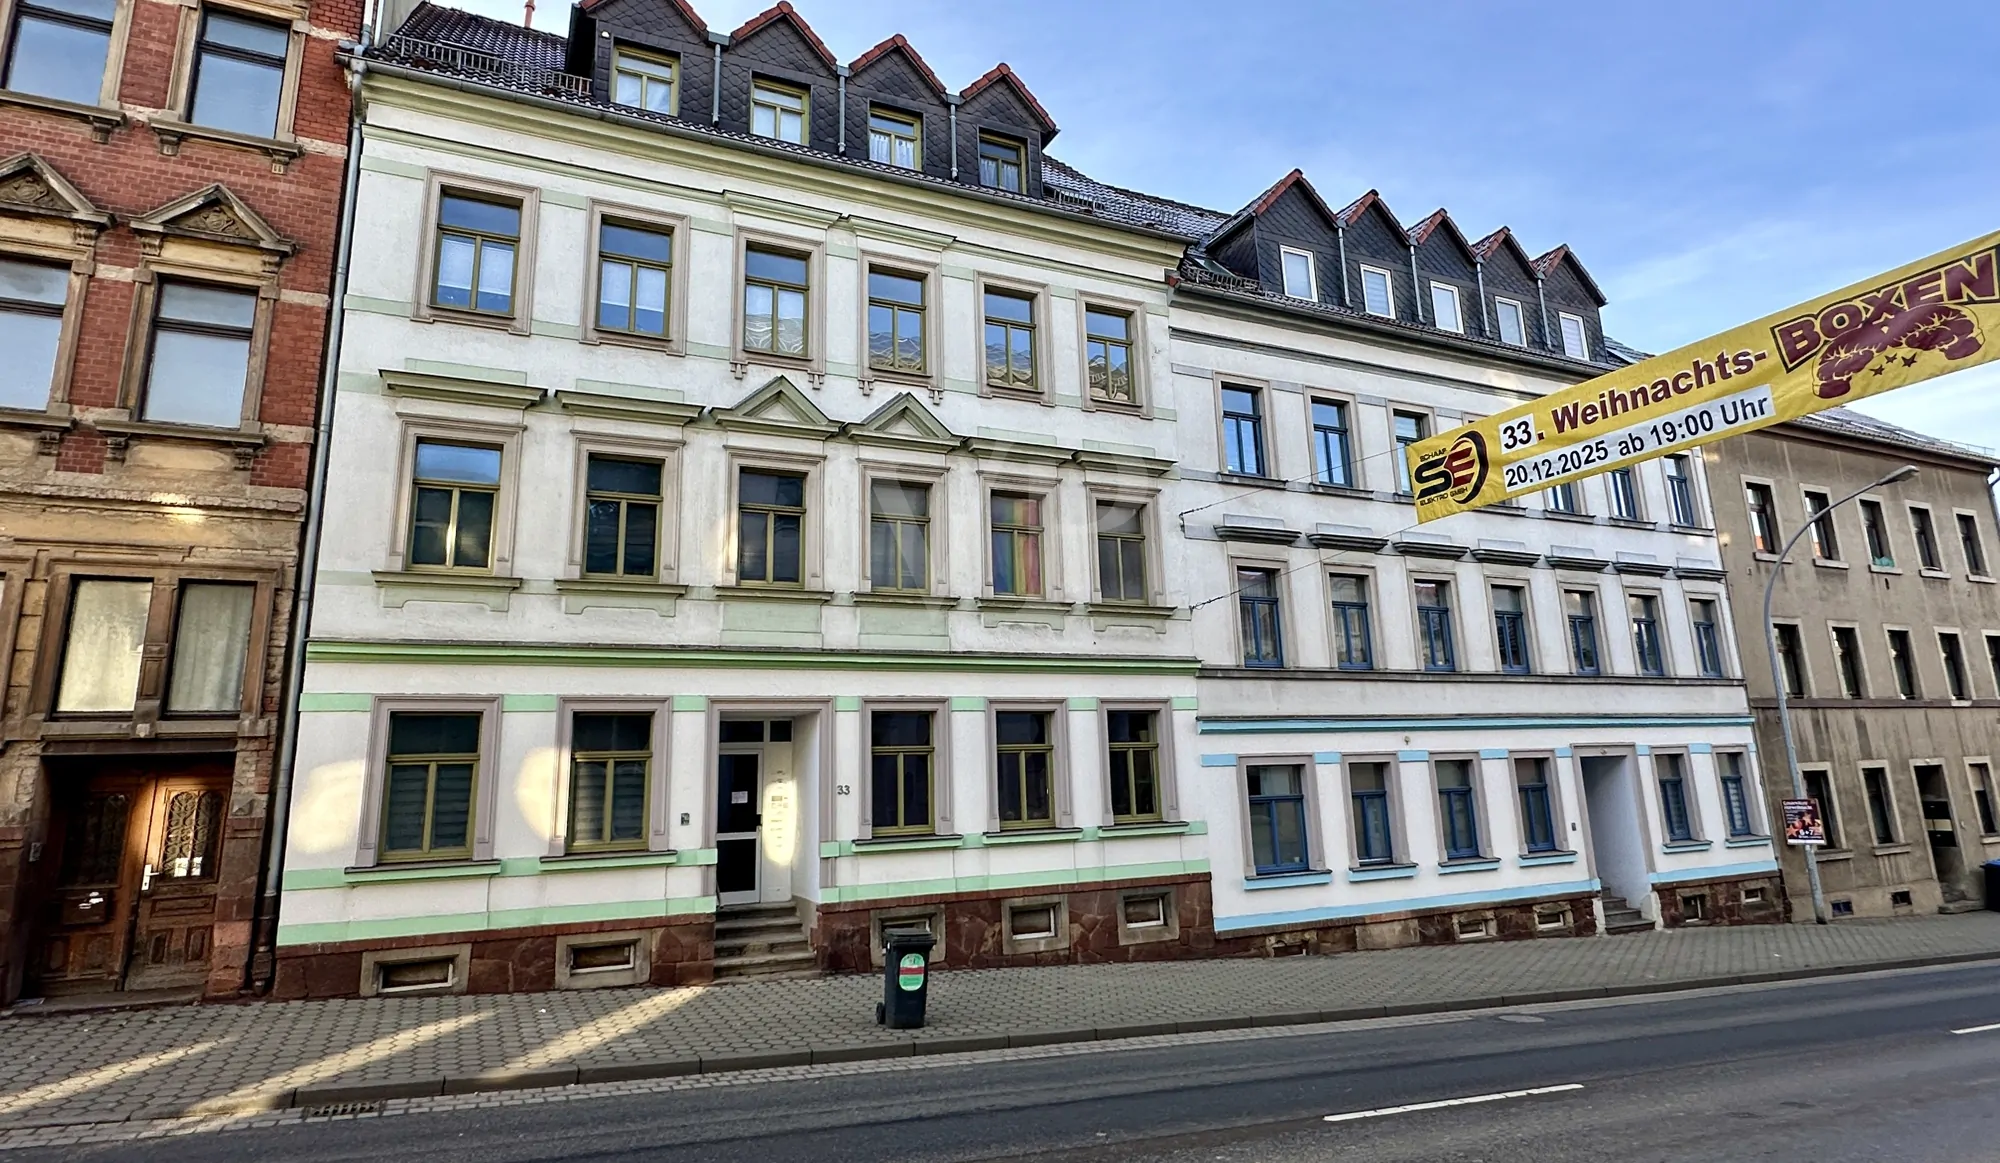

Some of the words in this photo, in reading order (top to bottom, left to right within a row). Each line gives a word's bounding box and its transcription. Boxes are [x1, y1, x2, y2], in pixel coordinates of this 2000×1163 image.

[1777, 252, 1995, 366] BOXEN
[1502, 420, 1545, 450] 33.
[1551, 352, 1767, 434] Weihnachts-
[1420, 448, 1447, 462] SCHAAF
[1505, 440, 1609, 487] 20.12.2025
[1618, 433, 1645, 457] ab
[1650, 410, 1714, 446] 19:00
[1720, 397, 1768, 426] Uhr
[1420, 493, 1448, 506] ELEKTRO
[837, 785, 850, 795] 33
